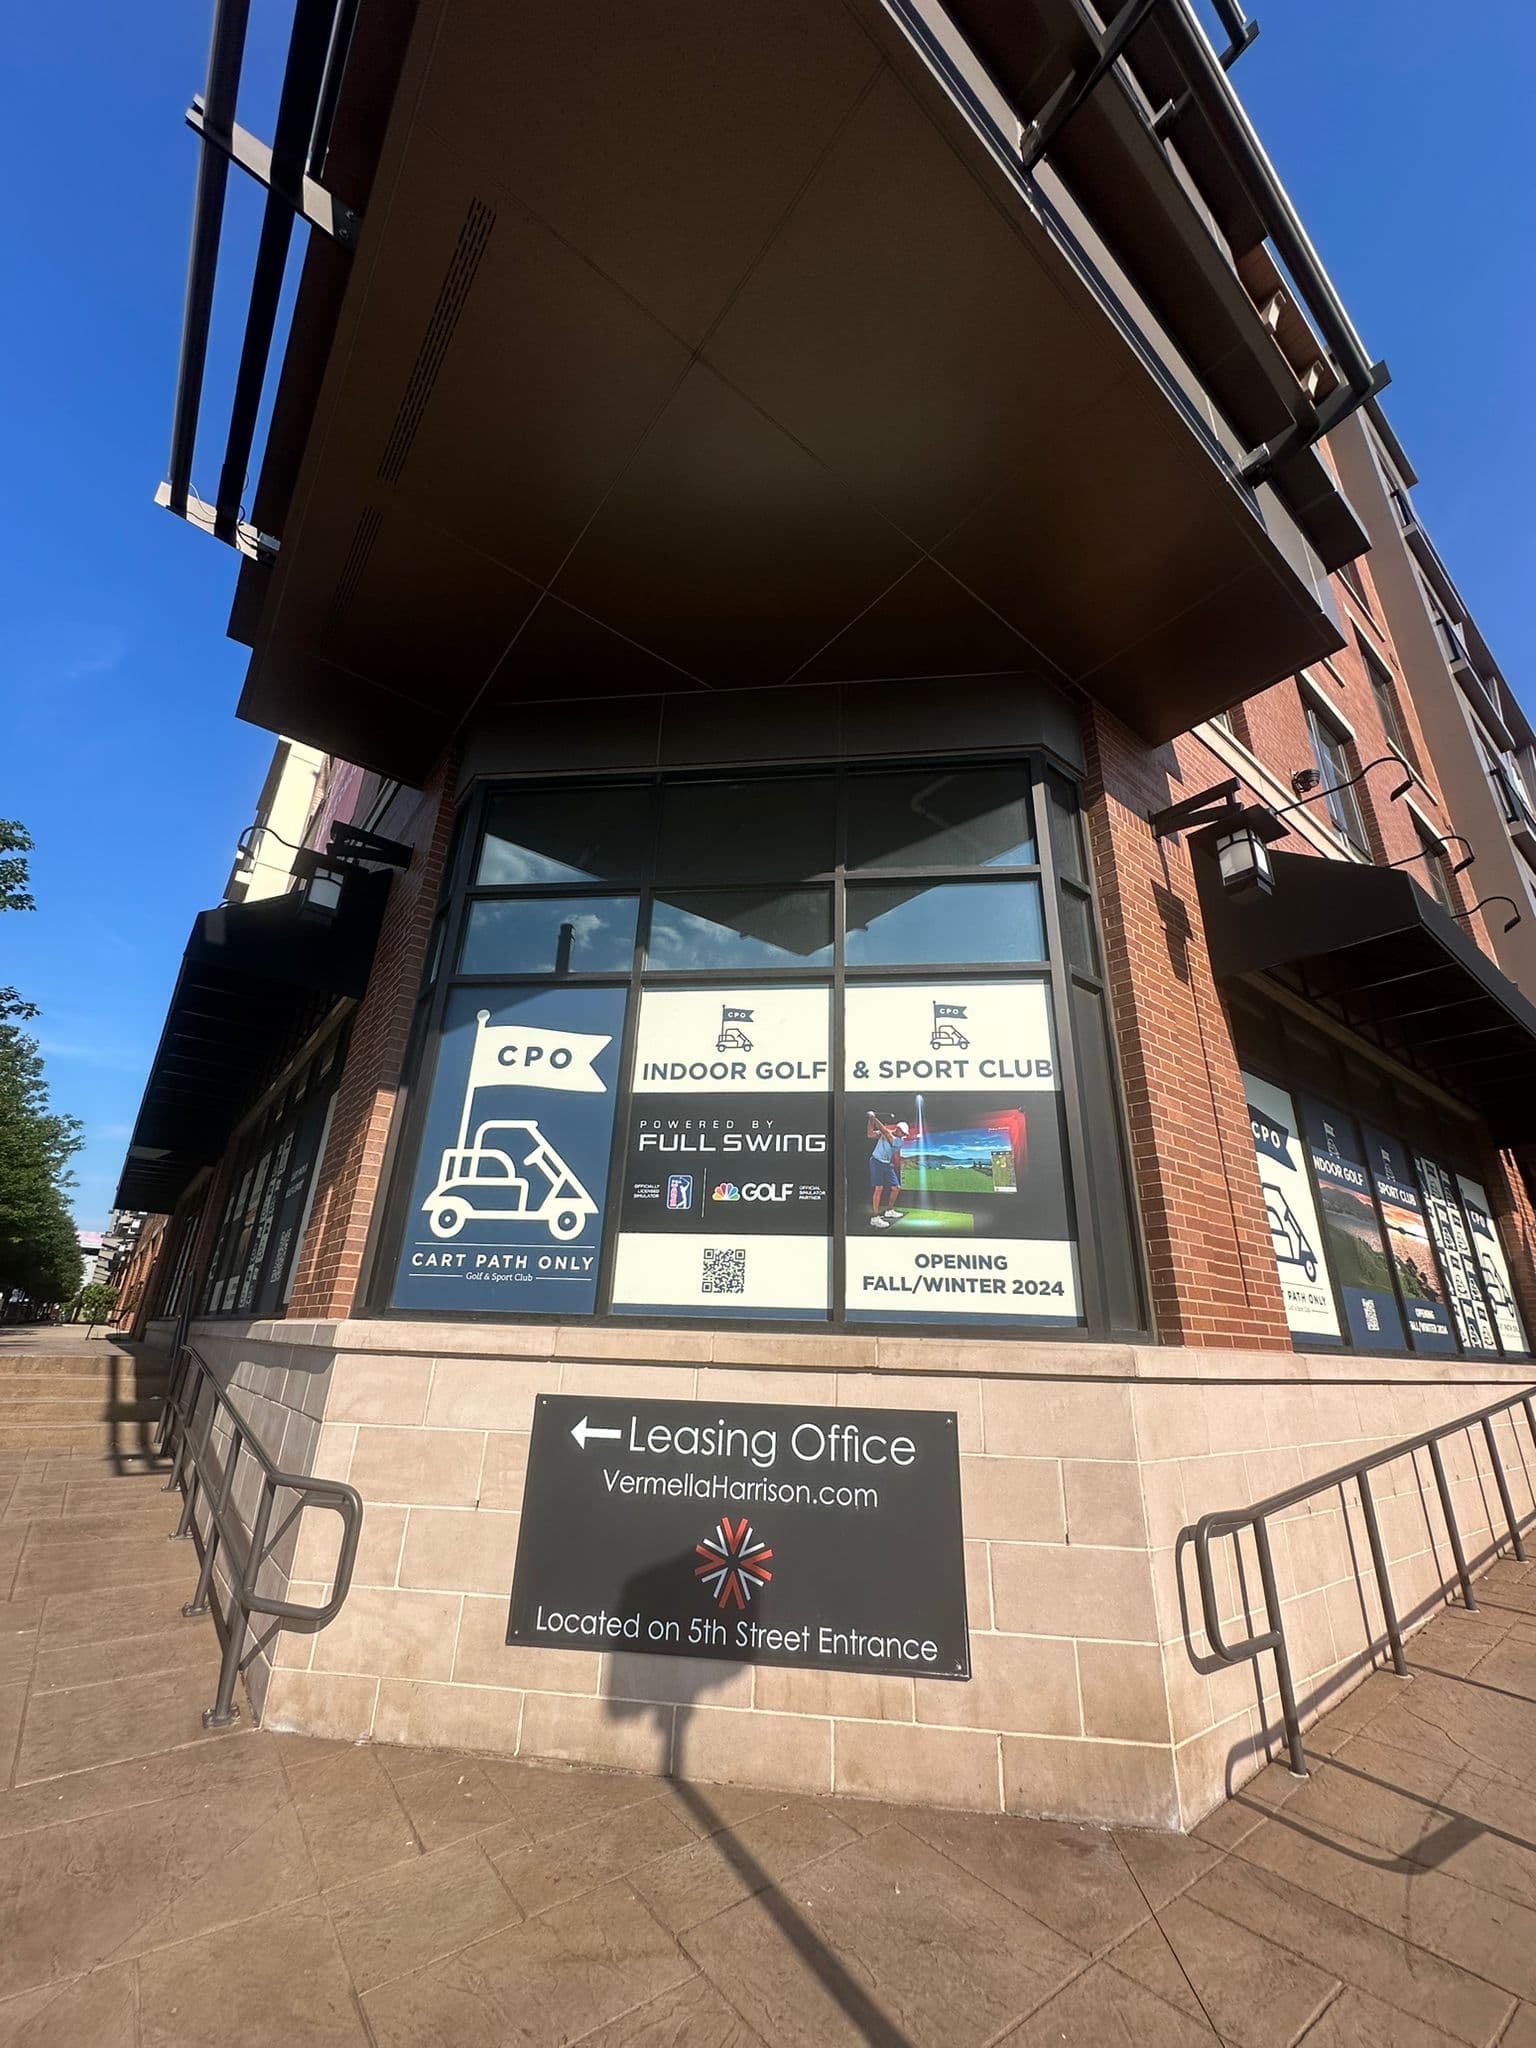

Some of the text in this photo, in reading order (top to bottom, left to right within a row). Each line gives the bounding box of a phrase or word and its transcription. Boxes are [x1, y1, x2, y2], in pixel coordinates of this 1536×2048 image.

[497, 1045, 572, 1069] CPO
[643, 1061, 827, 1080] INDOOR GOLF
[853, 1059, 1053, 1079] & SPORT CLUB
[640, 1120, 774, 1129] POWERED BY
[639, 1133, 826, 1152] FULL SWING
[1251, 1121, 1280, 1149] CPO
[1313, 1154, 1364, 1186] NDOOR GOLF
[741, 1183, 794, 1201] GOLF
[411, 1252, 594, 1271] CART PATH ONLY
[915, 1254, 1008, 1270] OPENING
[465, 1271, 482, 1281] Golf
[491, 1272, 513, 1282] Sport
[514, 1273, 533, 1282] Club
[863, 1275, 1065, 1296] FALL/WINTER 2024
[629, 1416, 916, 1468] Leasing Office
[603, 1469, 879, 1507] VermellaHarrison.com
[536, 1605, 938, 1662] Located on 5th Street Entrance
